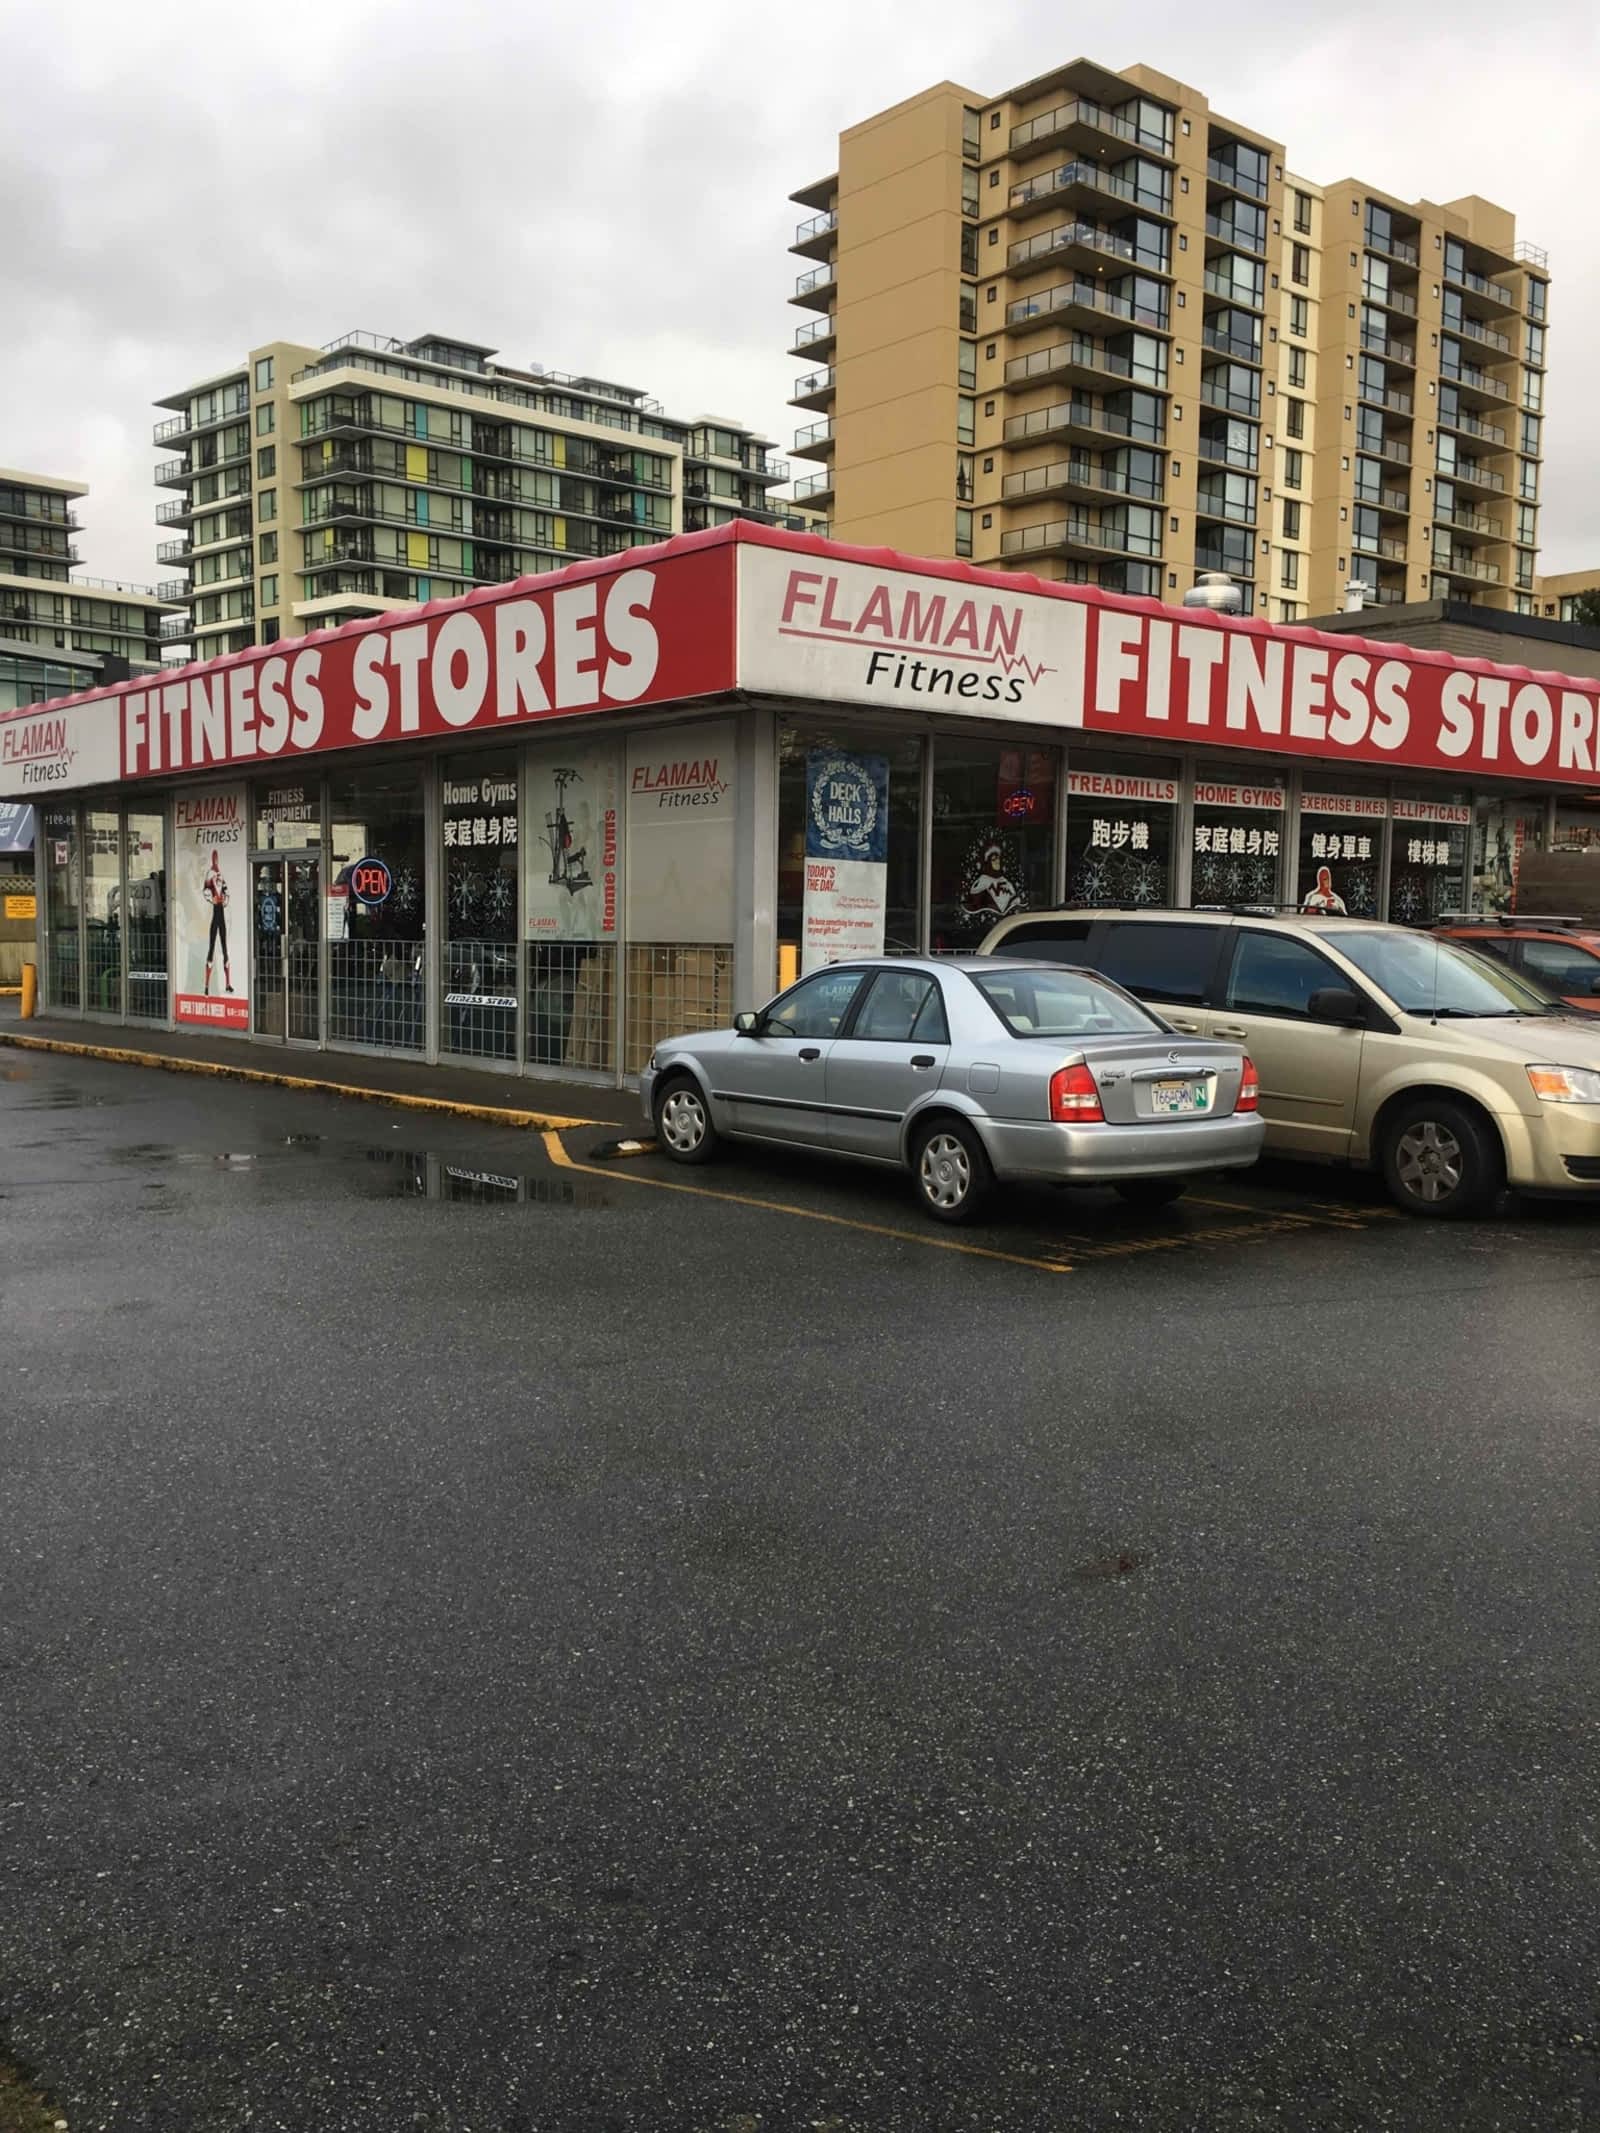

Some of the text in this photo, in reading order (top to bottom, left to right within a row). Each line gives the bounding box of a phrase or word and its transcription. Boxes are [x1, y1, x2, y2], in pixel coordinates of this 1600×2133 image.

[781, 570, 1023, 654] FLAMAN
[126, 568, 659, 775] FITNESS STORES
[866, 651, 1024, 703] Fitness
[1095, 609, 1412, 749] FITNESS
[3, 718, 66, 759] FLAMAN
[23, 762, 68, 784] Fitness
[632, 759, 718, 789] FLAMAN
[268, 788, 304, 805] FITNESS
[444, 778, 517, 807] Home Gyms
[659, 791, 720, 808] Fitness
[830, 781, 861, 802] DECK
[1069, 774, 1174, 800] TREADMILLS
[1195, 784, 1282, 808] HOME GYMS
[176, 794, 238, 825] FLAMAN
[261, 805, 312, 823] EQUIPMENT
[828, 805, 861, 825] HALLS
[1003, 797, 1034, 813] OPEN
[1301, 795, 1385, 816] EXERCISE BIKES
[1392, 802, 1469, 821] ELLIPTICALS
[195, 827, 240, 845] Fitness
[444, 815, 517, 847] 家庭健身院
[602, 809, 617, 867] Gyms
[1092, 819, 1149, 850] 跑步機
[1195, 825, 1279, 856] 家庭健身院
[1311, 833, 1372, 861] 健身單車
[807, 865, 835, 878] TODAY'S
[807, 879, 818, 891] THE
[602, 872, 616, 931] Home
[1195, 1087, 1206, 1100] N
